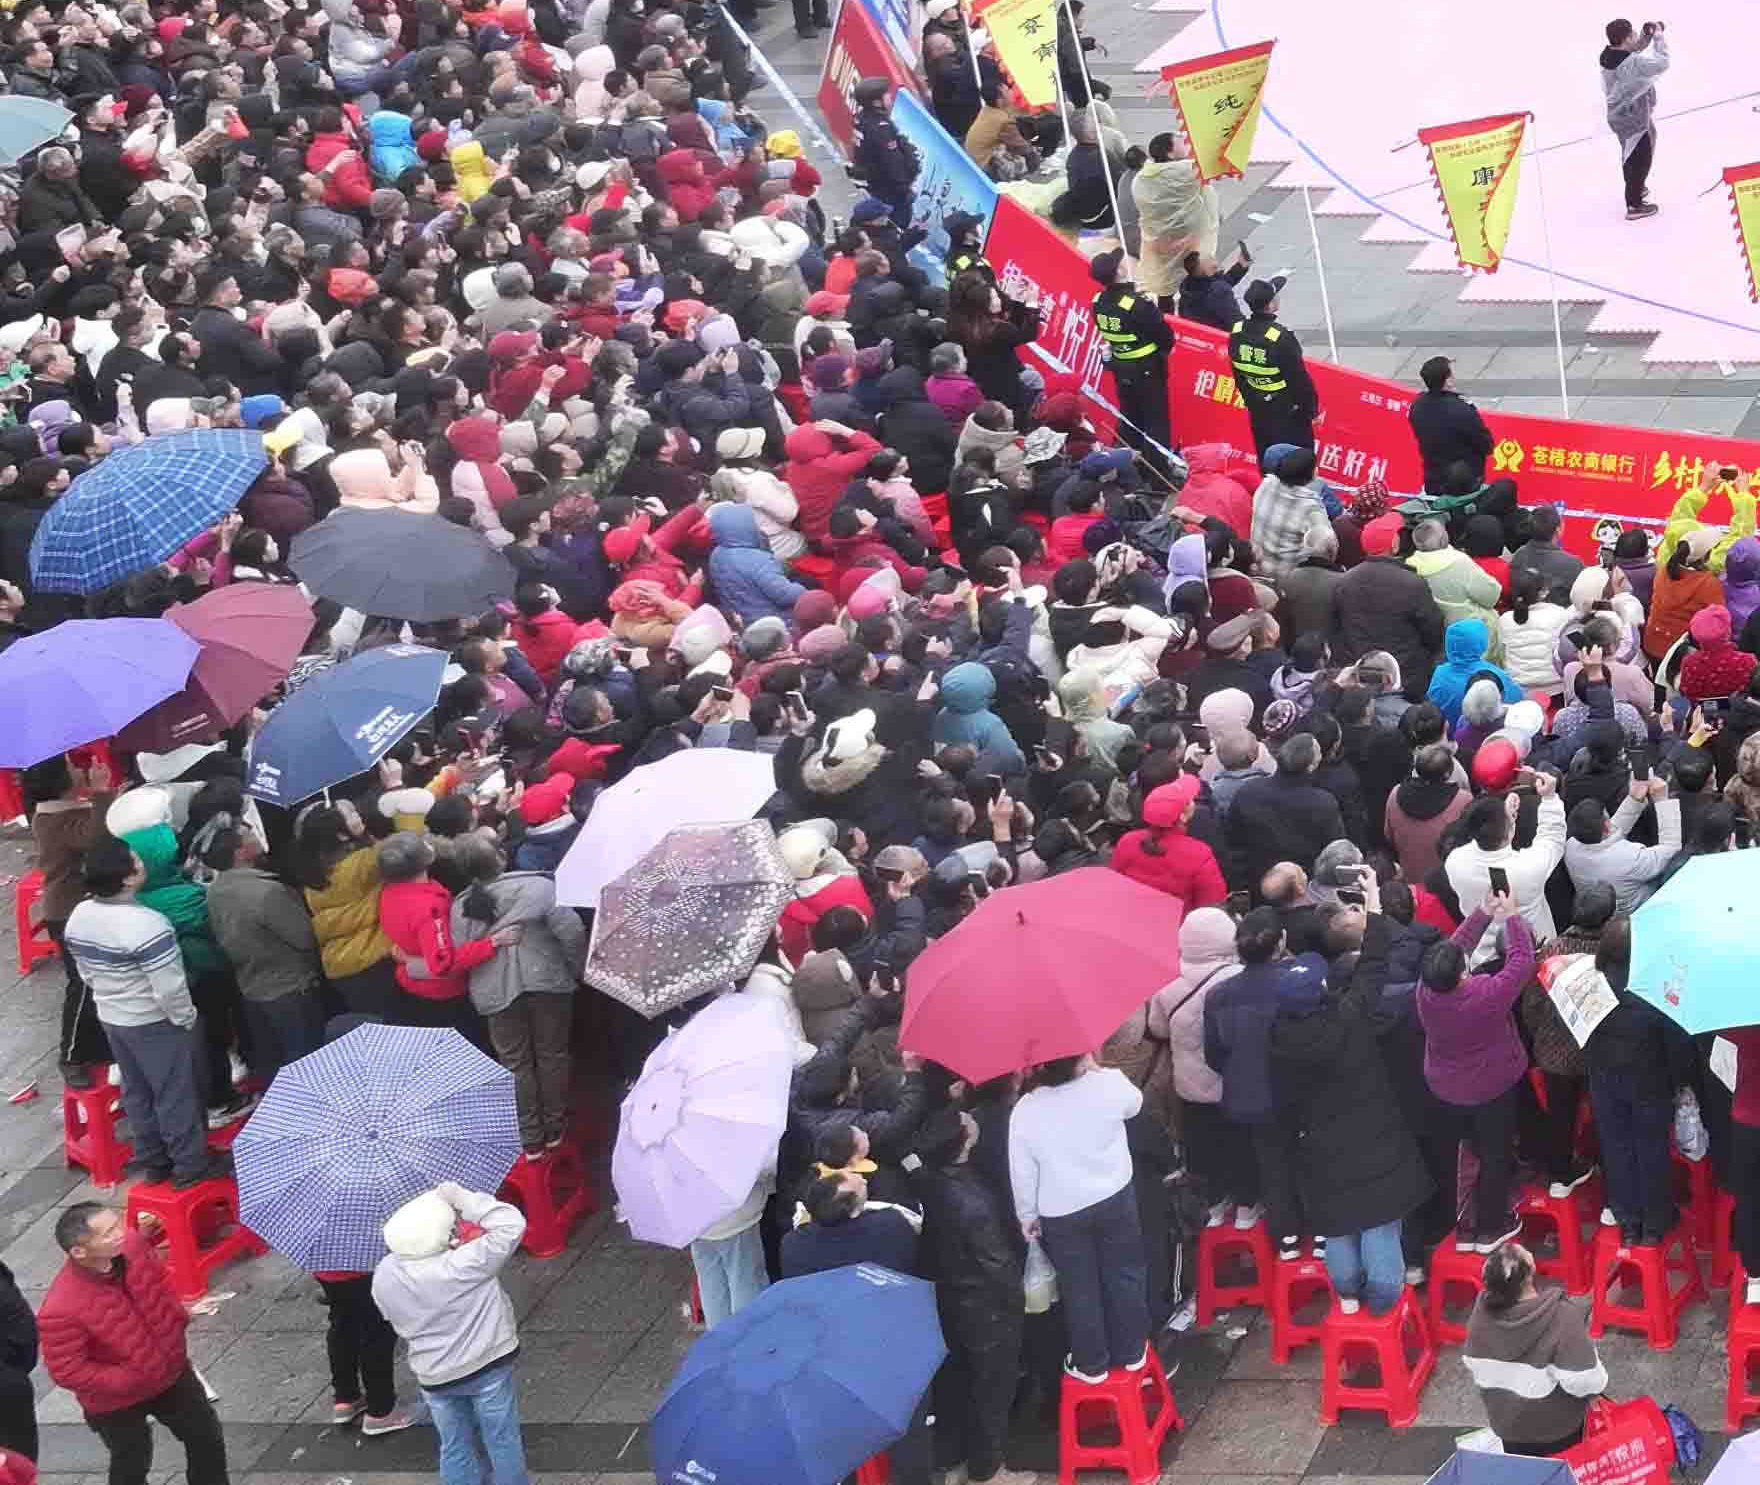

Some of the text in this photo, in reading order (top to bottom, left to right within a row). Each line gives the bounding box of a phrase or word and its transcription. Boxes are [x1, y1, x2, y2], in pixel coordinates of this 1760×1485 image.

[1239, 344, 1267, 364] 警察
[1532, 444, 1637, 476] 苍梧农商银行
